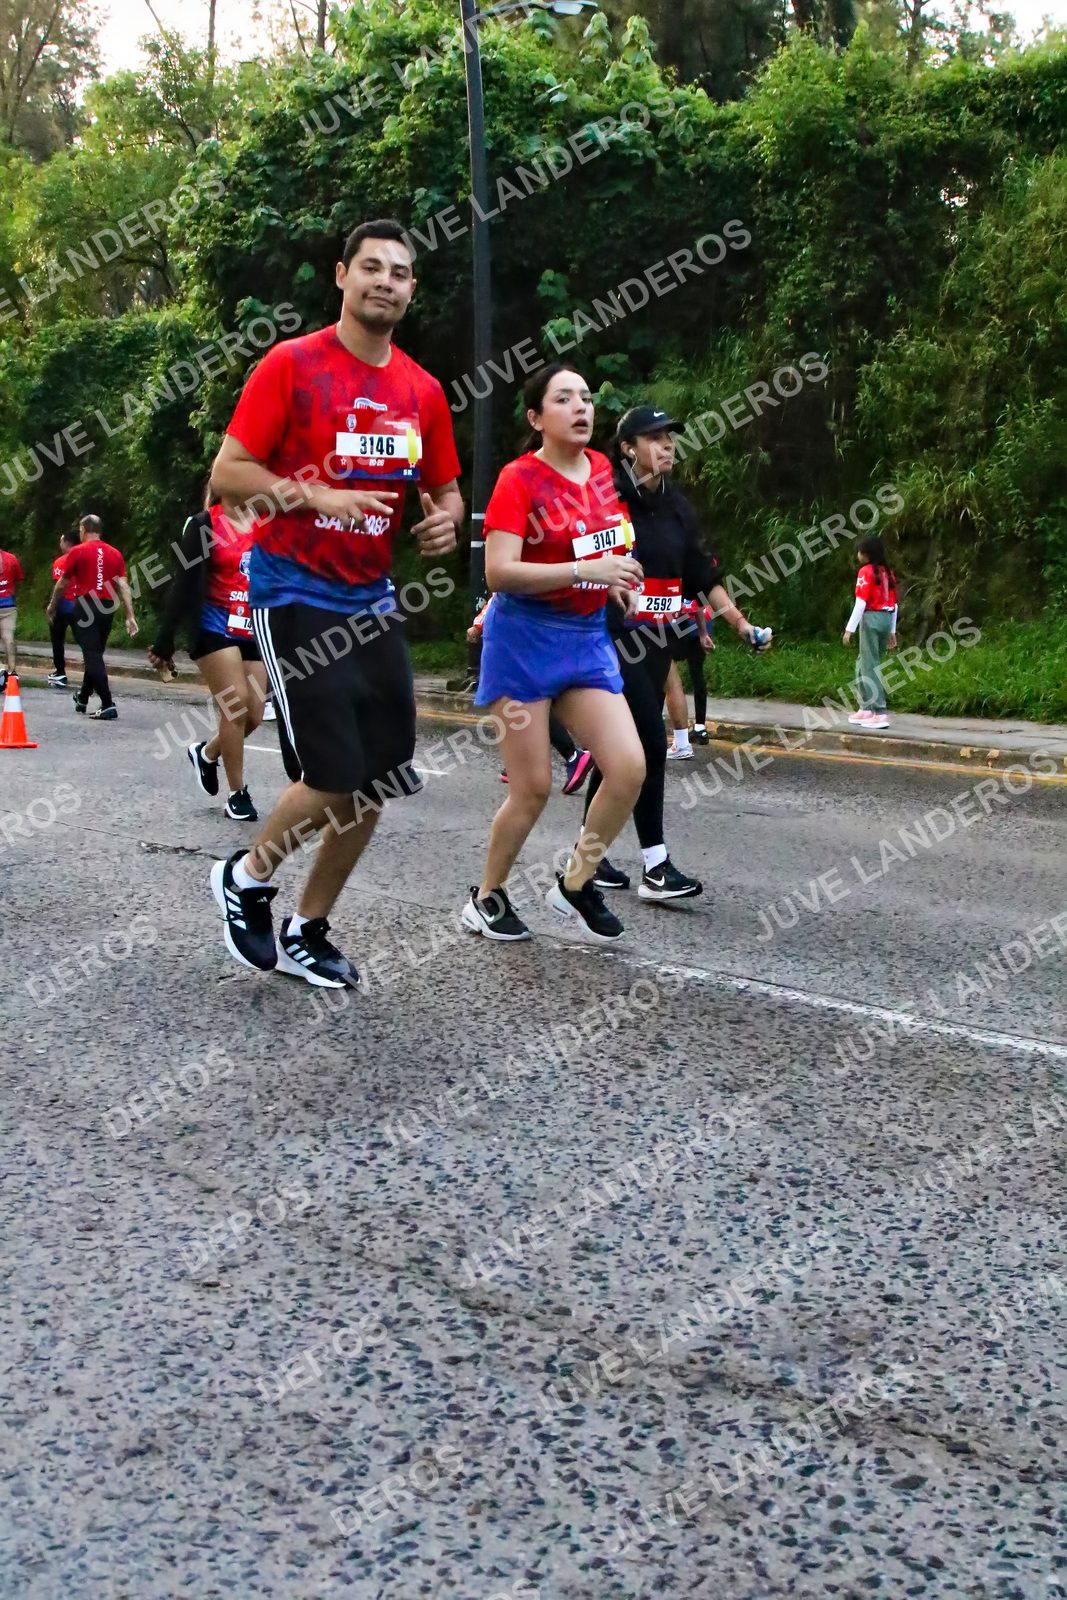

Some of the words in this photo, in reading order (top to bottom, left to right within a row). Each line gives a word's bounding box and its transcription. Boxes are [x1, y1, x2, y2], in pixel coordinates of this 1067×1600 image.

[360, 436, 394, 455] 3146
[593, 529, 616, 550] 3147
[646, 597, 672, 611] 2592
